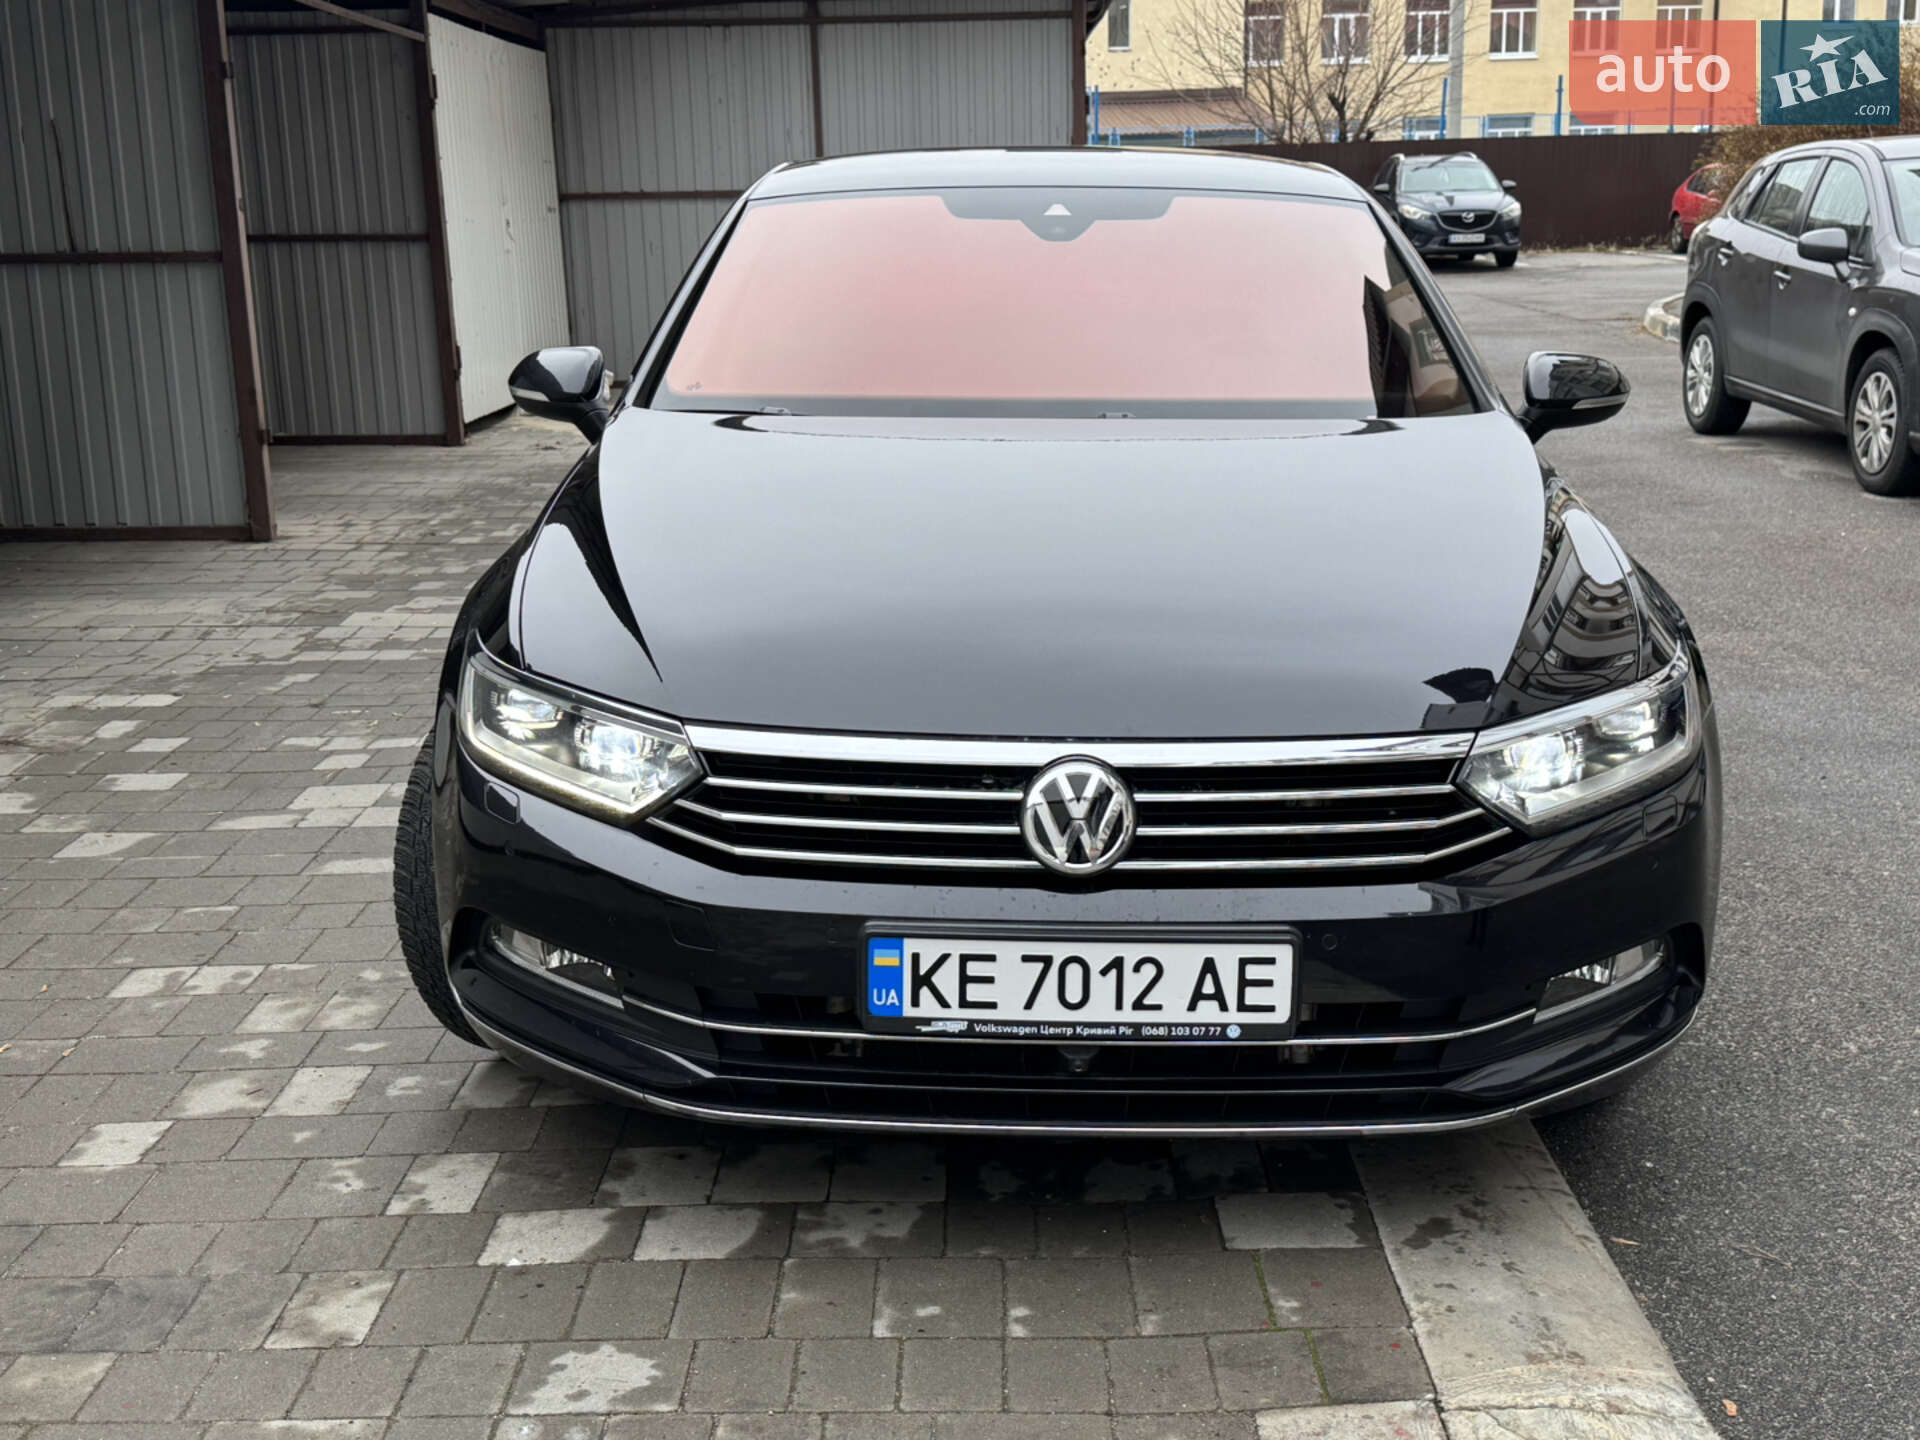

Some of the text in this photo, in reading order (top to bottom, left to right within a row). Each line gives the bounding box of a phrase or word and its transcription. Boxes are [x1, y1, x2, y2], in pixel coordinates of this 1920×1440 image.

[911, 952, 1277, 1013] KE 7012 AE
[873, 988, 900, 1007] UA
[974, 1023, 1037, 1035] Volkswagen
[1040, 1025, 1073, 1036] Центр
[1076, 1025, 1116, 1036] Кривий
[1119, 1026, 1134, 1036] Ріг
[1141, 1026, 1169, 1037] (068)
[1171, 1026, 1190, 1036] 103
[1192, 1027, 1205, 1036] 07
[1208, 1027, 1221, 1037] 77
